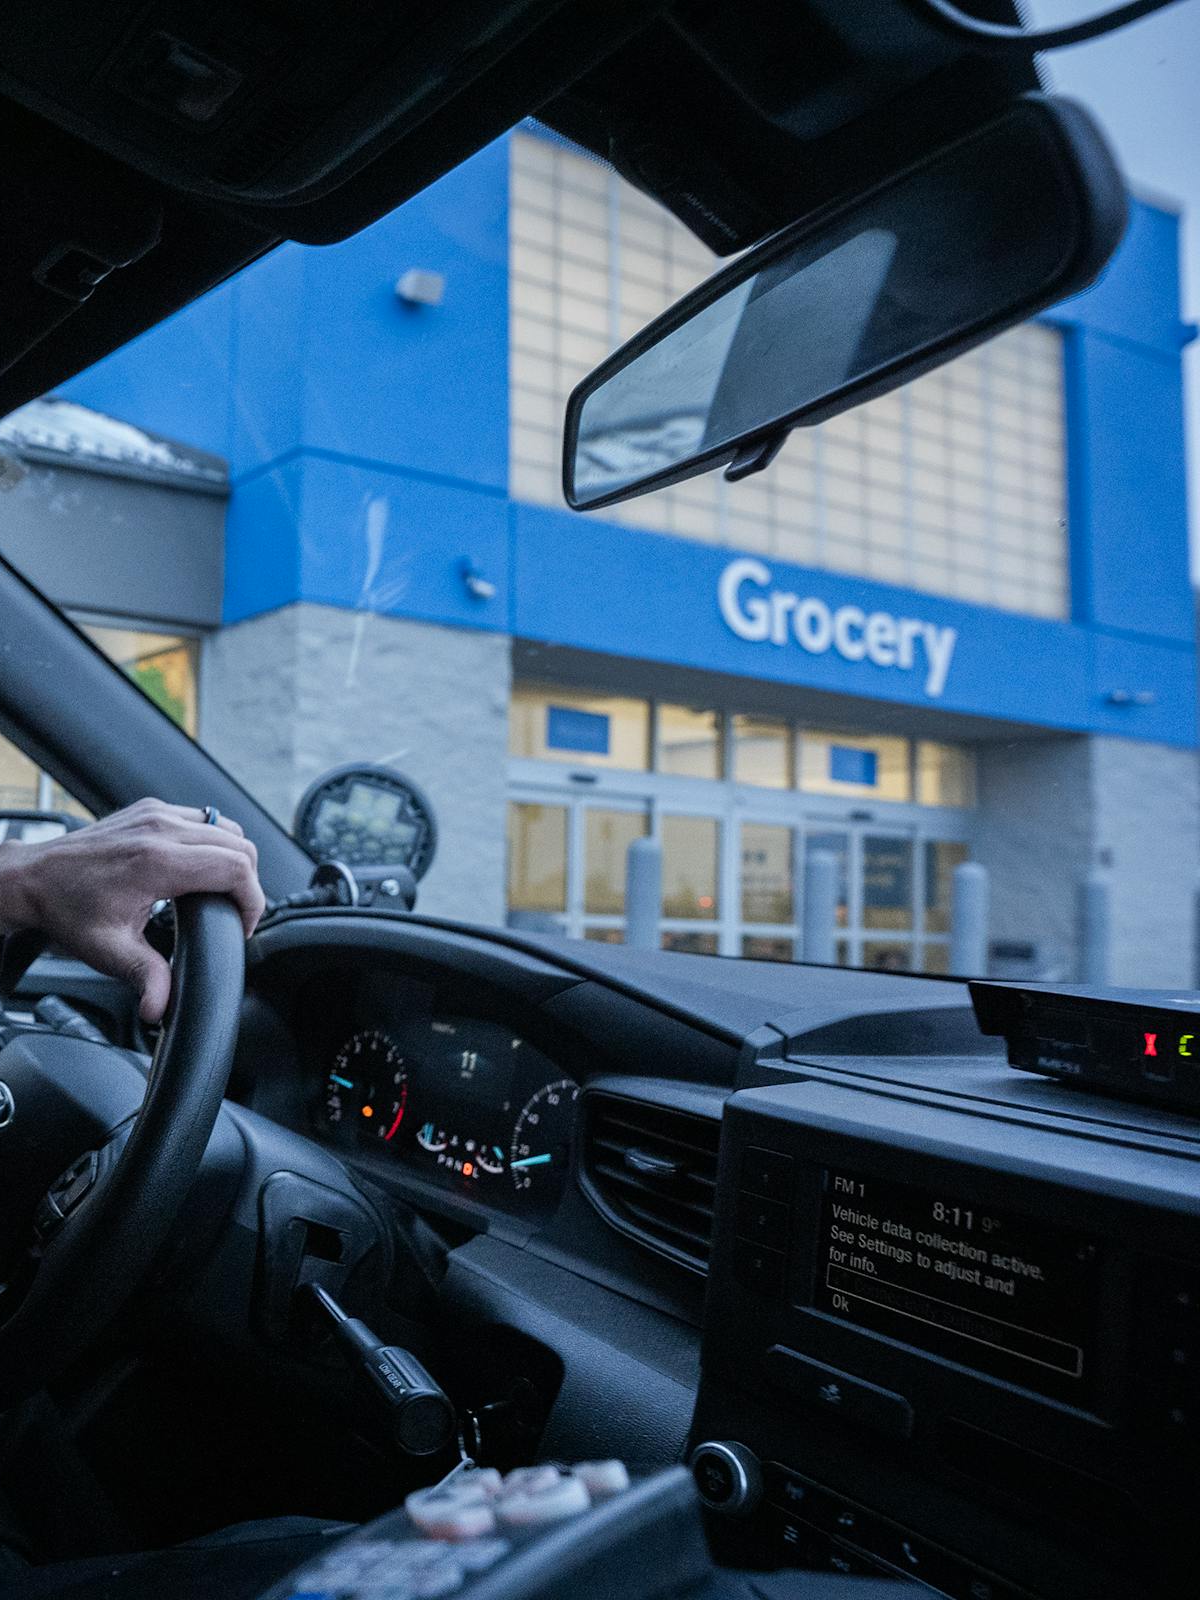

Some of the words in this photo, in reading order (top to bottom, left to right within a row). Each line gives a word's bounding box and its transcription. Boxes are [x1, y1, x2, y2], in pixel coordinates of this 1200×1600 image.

[717, 557, 957, 698] Grocery
[834, 1176, 855, 1195] FM
[858, 1183, 866, 1198] 1
[932, 1200, 974, 1231] 8:11
[832, 1203, 880, 1231] Vehicle
[882, 1218, 913, 1242] data
[915, 1231, 988, 1264] collection
[990, 1252, 1045, 1282] active.
[828, 1245, 848, 1264] for
[850, 1253, 879, 1276] info.
[830, 1225, 855, 1246] See
[858, 1233, 914, 1265] Settings
[916, 1252, 932, 1270] to
[933, 1260, 982, 1287] adjust
[983, 1273, 1016, 1297] and
[832, 1292, 850, 1313] Ok
